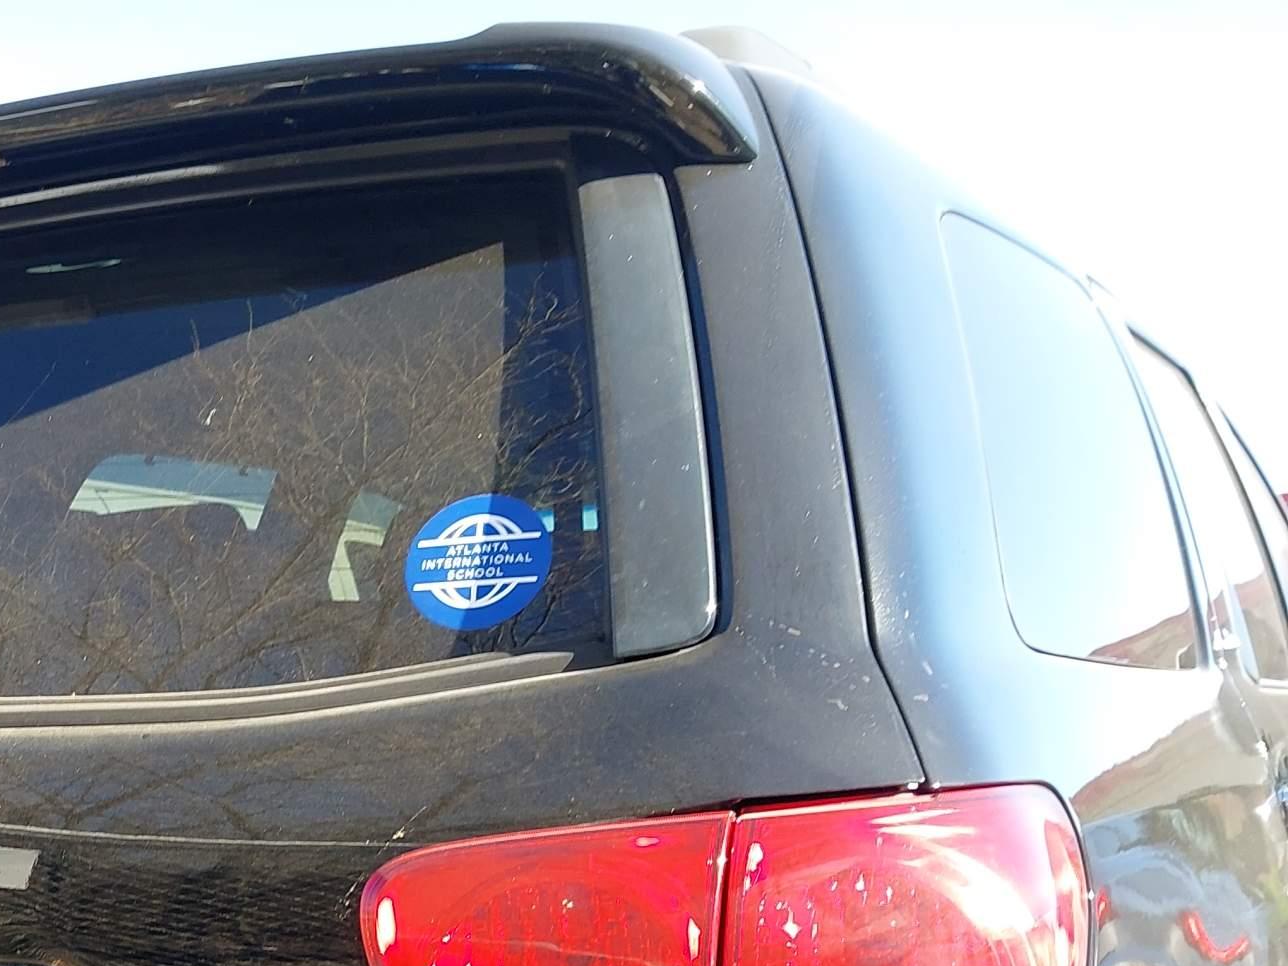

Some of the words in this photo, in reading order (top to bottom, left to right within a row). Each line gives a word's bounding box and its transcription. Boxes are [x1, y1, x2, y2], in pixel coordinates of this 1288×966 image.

[446, 542, 509, 557] ATLANTA
[421, 552, 533, 571] INTERNATIONAL
[447, 566, 504, 581] SCHOOL
